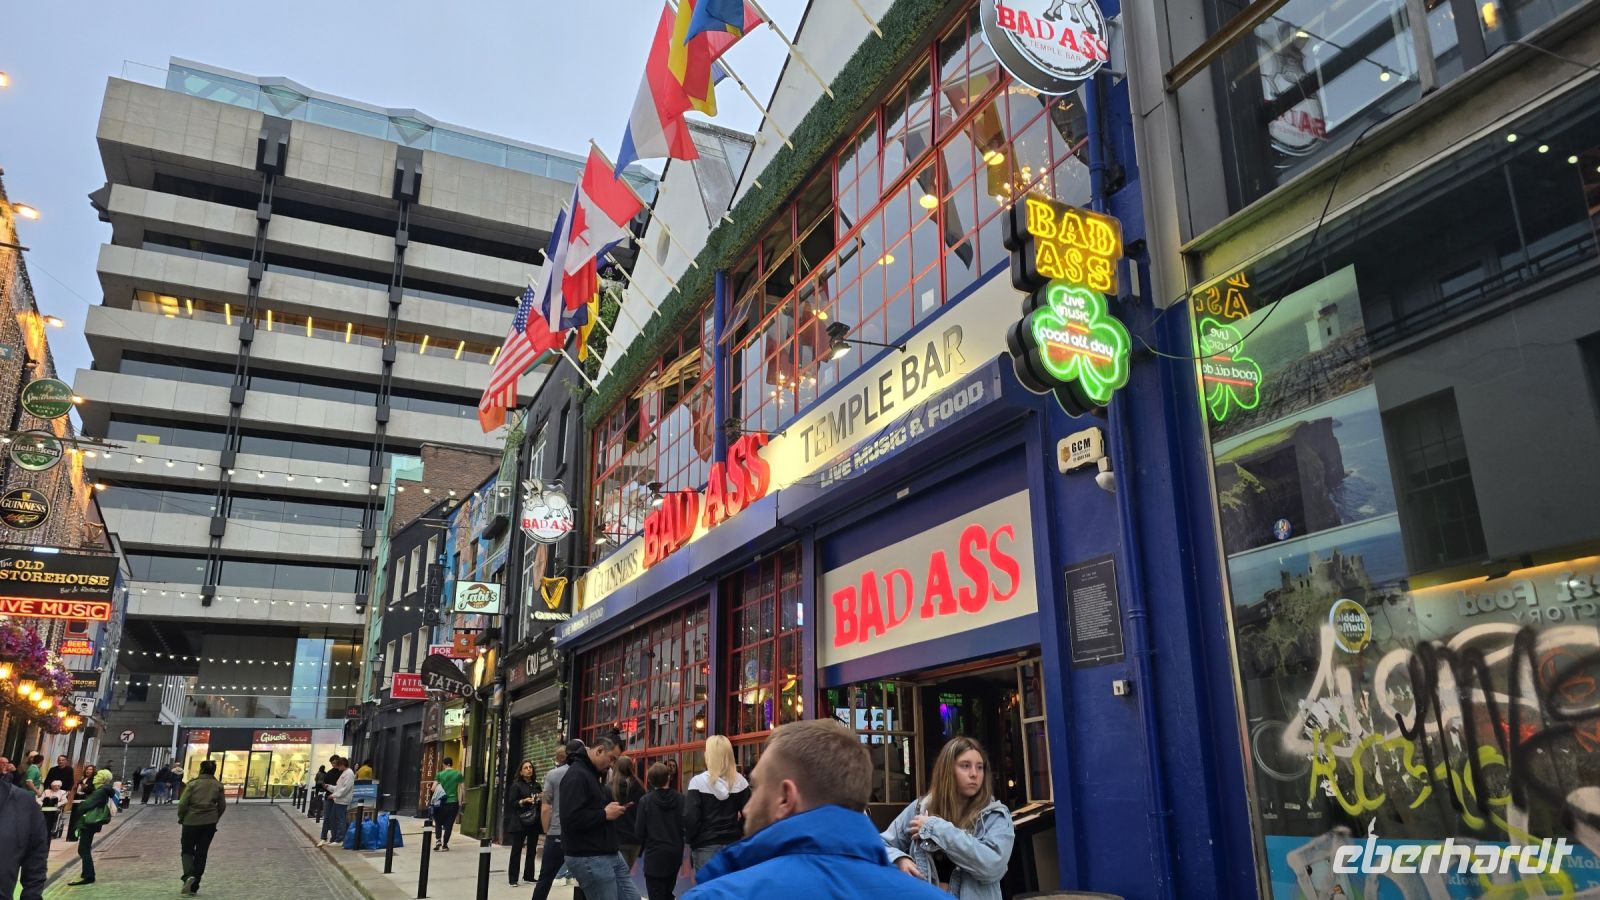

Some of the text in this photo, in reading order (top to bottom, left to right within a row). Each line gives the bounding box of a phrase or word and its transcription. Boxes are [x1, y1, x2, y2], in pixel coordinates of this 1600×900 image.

[996, 4, 1110, 62] BAD ASS
[1030, 40, 1082, 62] TEMPLE BAR
[1026, 199, 1115, 255] BAD
[1036, 241, 1111, 290] ASS
[1071, 335, 1089, 349] all
[1090, 341, 1115, 358] day
[800, 324, 967, 463] TEMPLE BAR
[820, 381, 984, 489] LIVE MUSIC & FOOD
[1071, 437, 1091, 453] GCM
[2, 500, 47, 513] GUINNESS
[643, 431, 771, 569] BAD ASS
[522, 518, 576, 532] BAD ASS
[15, 560, 45, 570] OLD
[593, 549, 639, 600] GUINNESS
[0, 569, 110, 586] STOREHOUSE
[832, 568, 914, 648] BAD
[920, 523, 1021, 620] ASS
[428, 568, 441, 620] TATTOO
[41, 601, 105, 618] MUSIC
[61, 647, 92, 655] GARDEN
[67, 640, 88, 648] BEER
